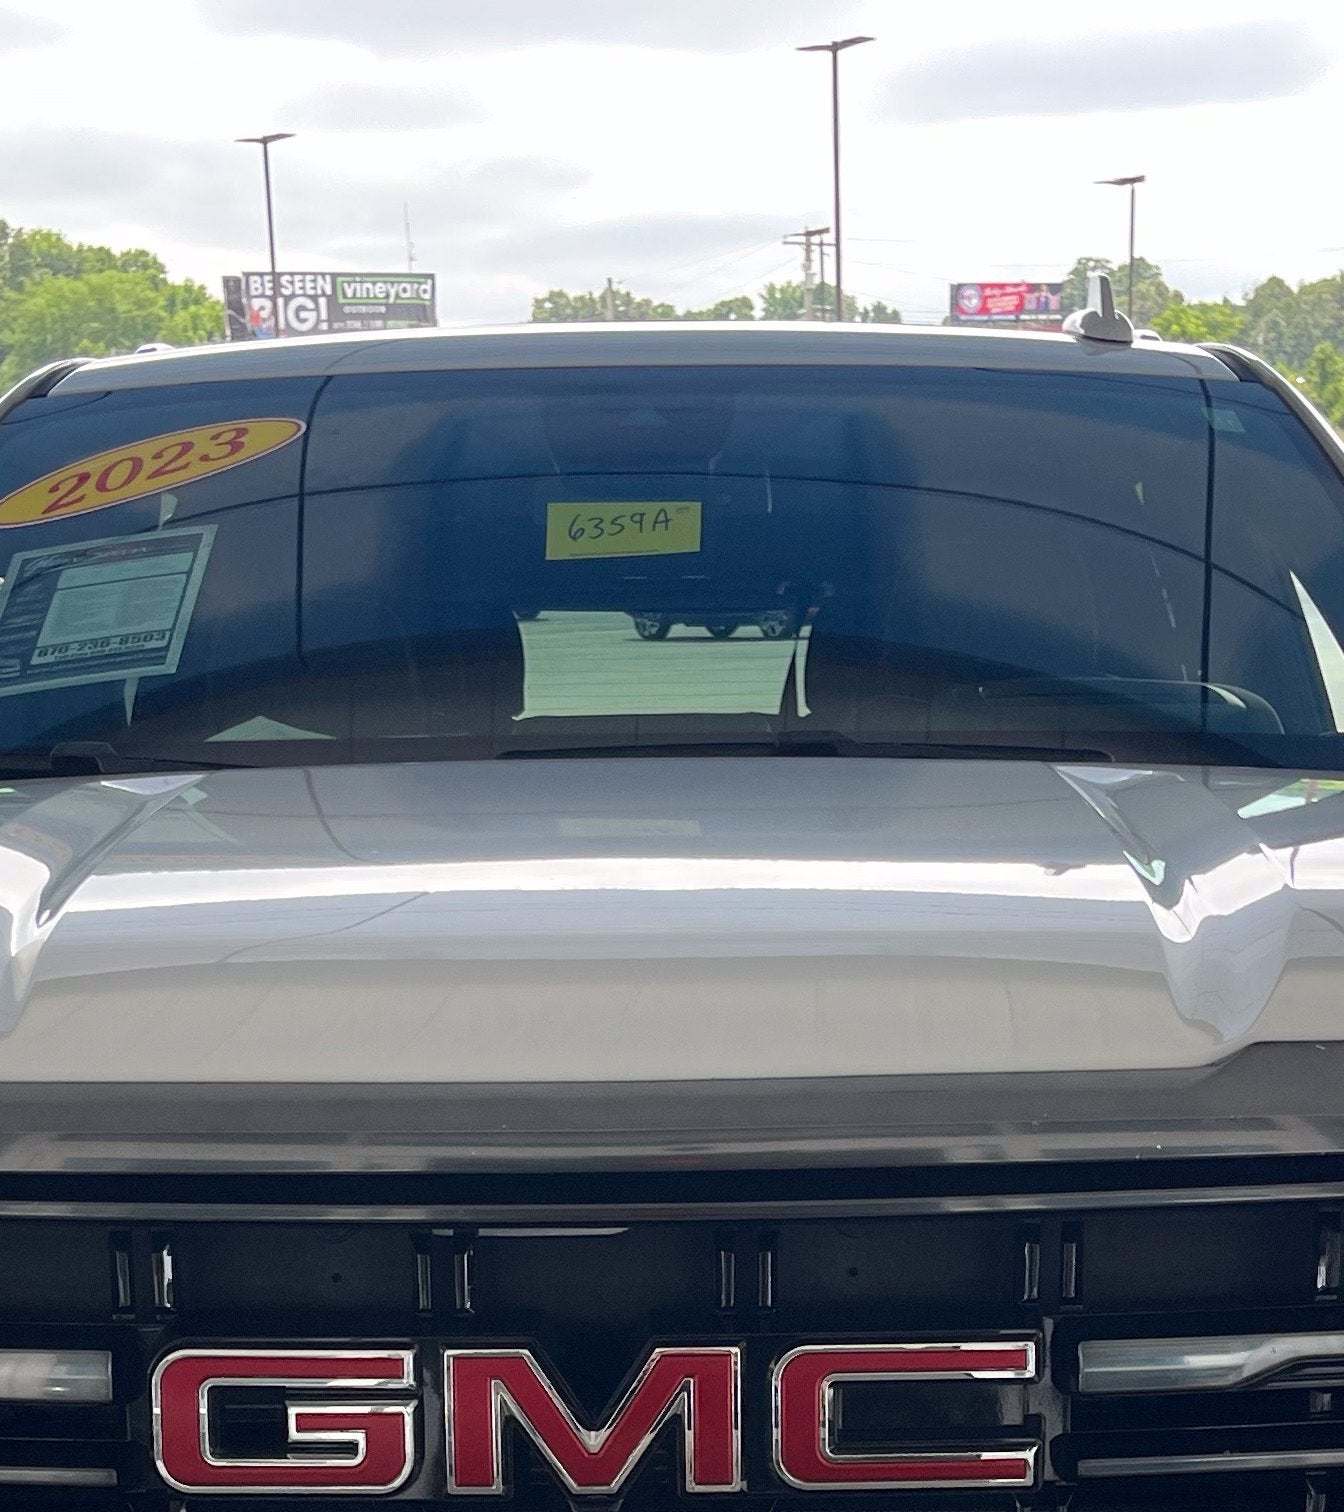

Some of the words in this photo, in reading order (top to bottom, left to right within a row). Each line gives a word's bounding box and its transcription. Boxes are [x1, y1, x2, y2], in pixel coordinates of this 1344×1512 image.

[248, 275, 274, 296] BE
[279, 275, 332, 296] SEEN
[343, 277, 433, 304] vineyard
[42, 426, 249, 514] 2023
[568, 508, 673, 542] 6359A
[152, 1344, 1040, 1495] GMC
